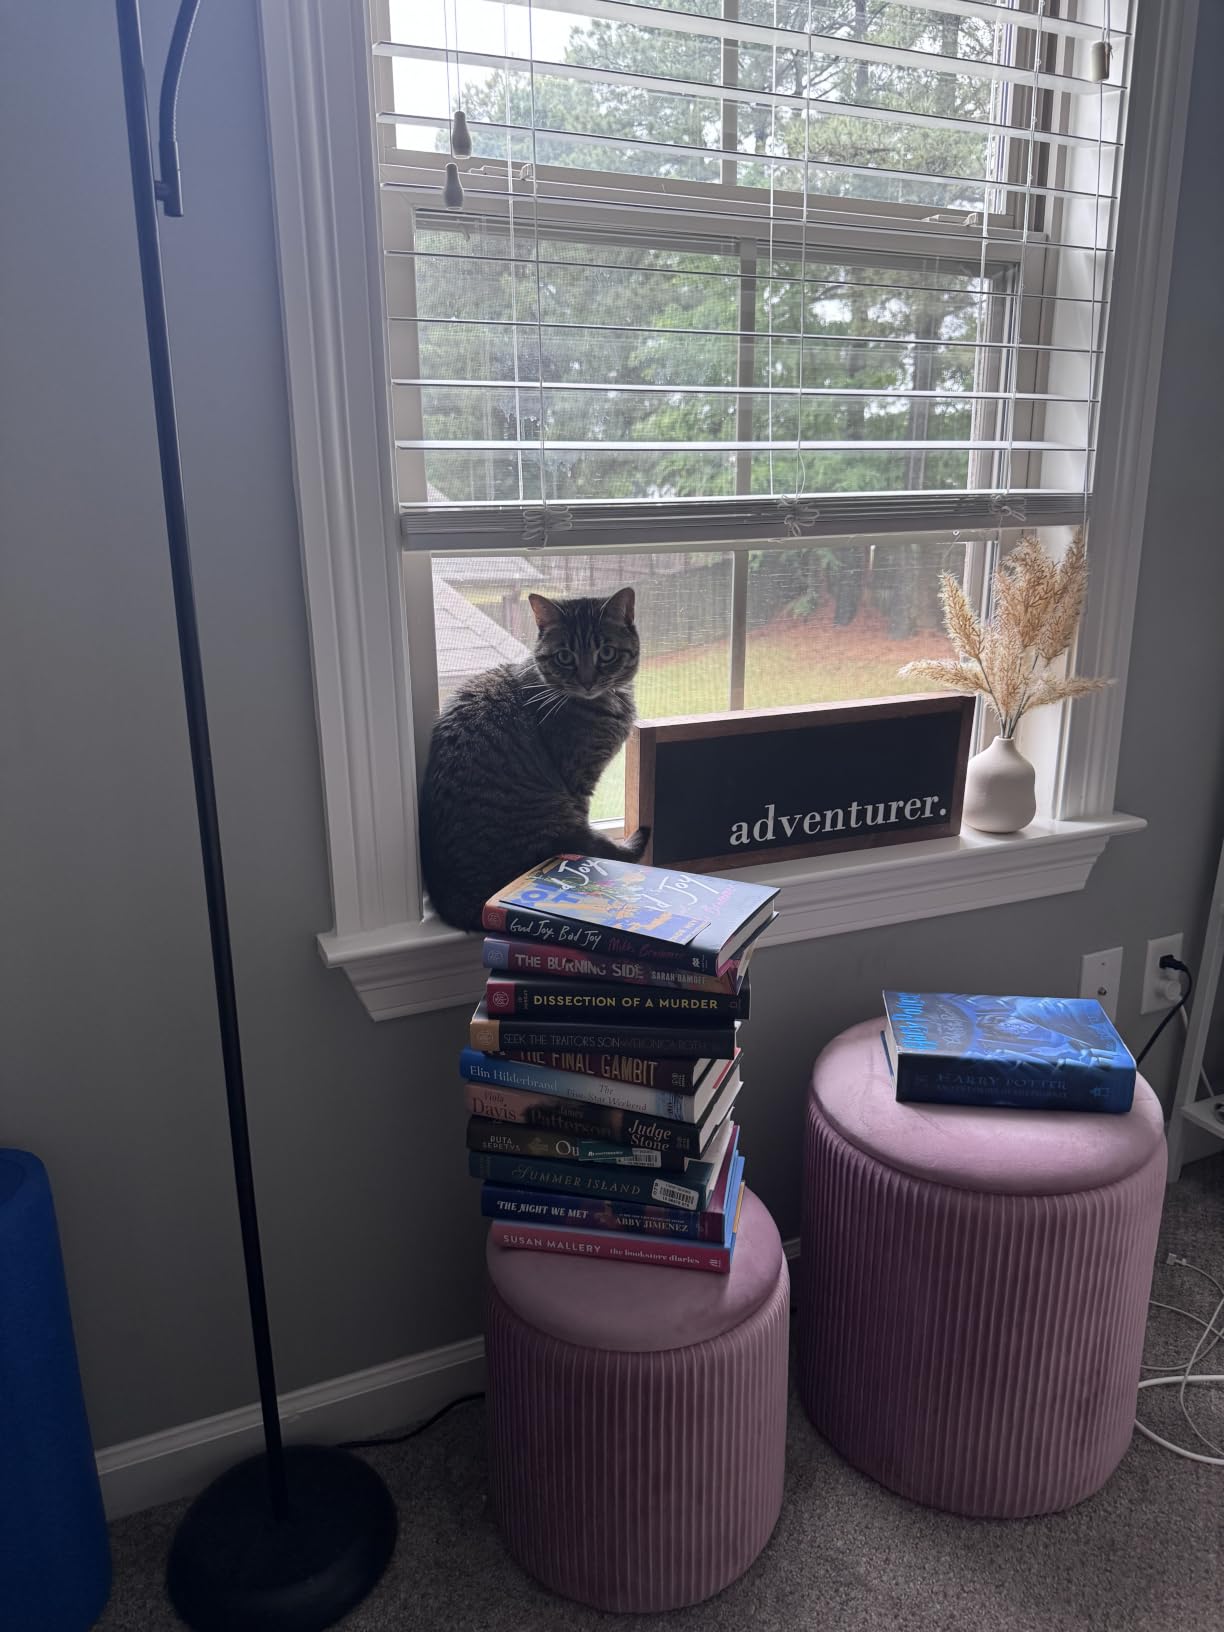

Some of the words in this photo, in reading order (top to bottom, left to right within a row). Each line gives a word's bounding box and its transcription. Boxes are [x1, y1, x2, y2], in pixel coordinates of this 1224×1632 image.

[729, 795, 947, 846] adventurer.
[558, 858, 608, 887] Joy
[659, 875, 720, 906] Joy
[510, 918, 533, 933] Good
[558, 925, 583, 940] Bad
[579, 930, 602, 951] Joy
[514, 954, 541, 968] THE
[547, 957, 606, 975] BURNING
[611, 962, 645, 979] SIDE
[651, 970, 675, 981] SARAH
[533, 996, 616, 1007] DISSECTION
[621, 997, 640, 1007] OF
[644, 999, 654, 1008] A
[659, 999, 718, 1009] MURDER
[504, 1034, 526, 1043] SEEK
[528, 1034, 547, 1045] THE
[599, 1037, 619, 1048] SON
[470, 1065, 490, 1078] Elin
[493, 1069, 557, 1091] Hilderbrand
[552, 1052, 595, 1074] FINAL
[600, 1055, 659, 1087] GAMBIT
[600, 1084, 614, 1095] The
[473, 1097, 517, 1120] Davis
[609, 1097, 647, 1111] Weekend
[628, 1120, 672, 1140] Judge
[490, 1136, 512, 1144] RUTA
[630, 1134, 670, 1151] Stone
[512, 1166, 581, 1186] SUMMER
[585, 1178, 641, 1195] ISLAND
[497, 1200, 517, 1211] THE
[517, 1203, 549, 1214] NIGHT
[551, 1206, 566, 1216] WE
[567, 1208, 589, 1219] MET
[615, 1217, 641, 1227] ABBY
[643, 1219, 689, 1232] JIMENEZ
[503, 1235, 542, 1246] SUSAN
[547, 1241, 600, 1253] MALLERY
[610, 1247, 623, 1256] the
[625, 1249, 667, 1261] bookstore
[668, 1254, 700, 1265] diaries
